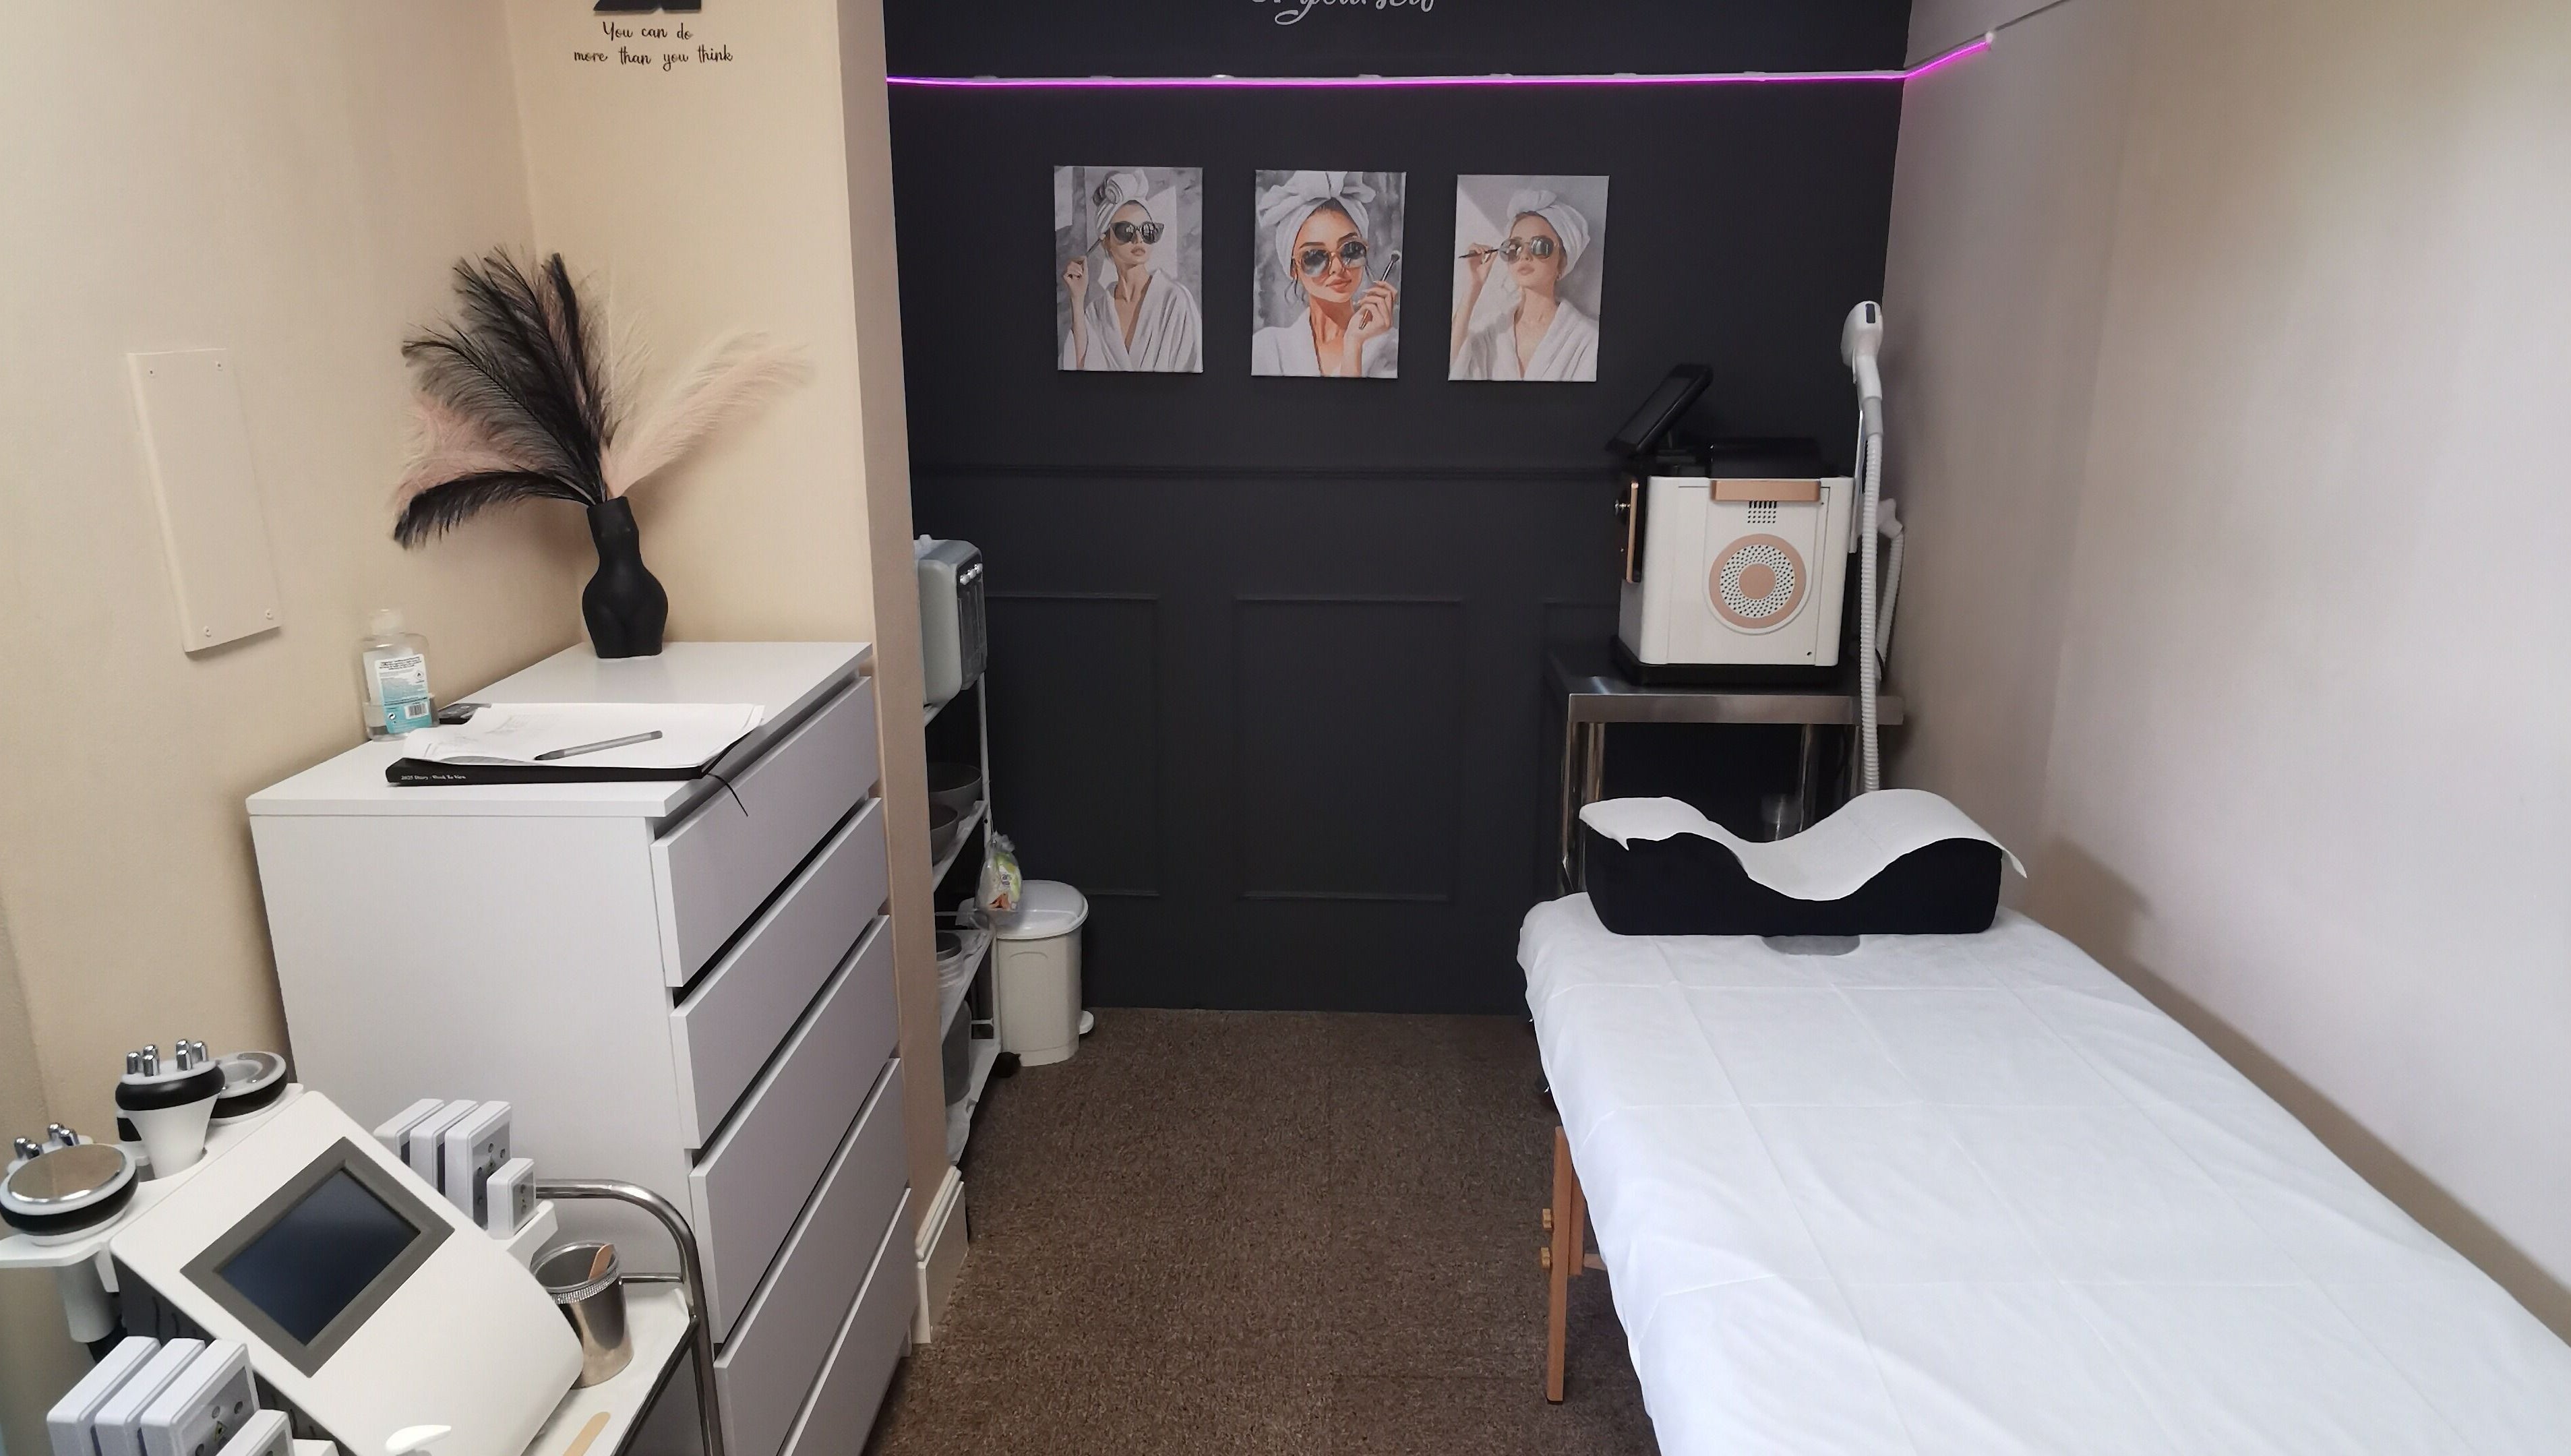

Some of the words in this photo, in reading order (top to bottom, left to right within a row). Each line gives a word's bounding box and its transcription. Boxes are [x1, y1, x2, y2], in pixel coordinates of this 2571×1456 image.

[603, 22, 633, 41] You
[642, 28, 667, 38] can
[677, 22, 693, 40] do
[574, 52, 608, 62] more
[618, 46, 651, 65] than
[663, 54, 688, 71] you
[698, 44, 733, 63] think
